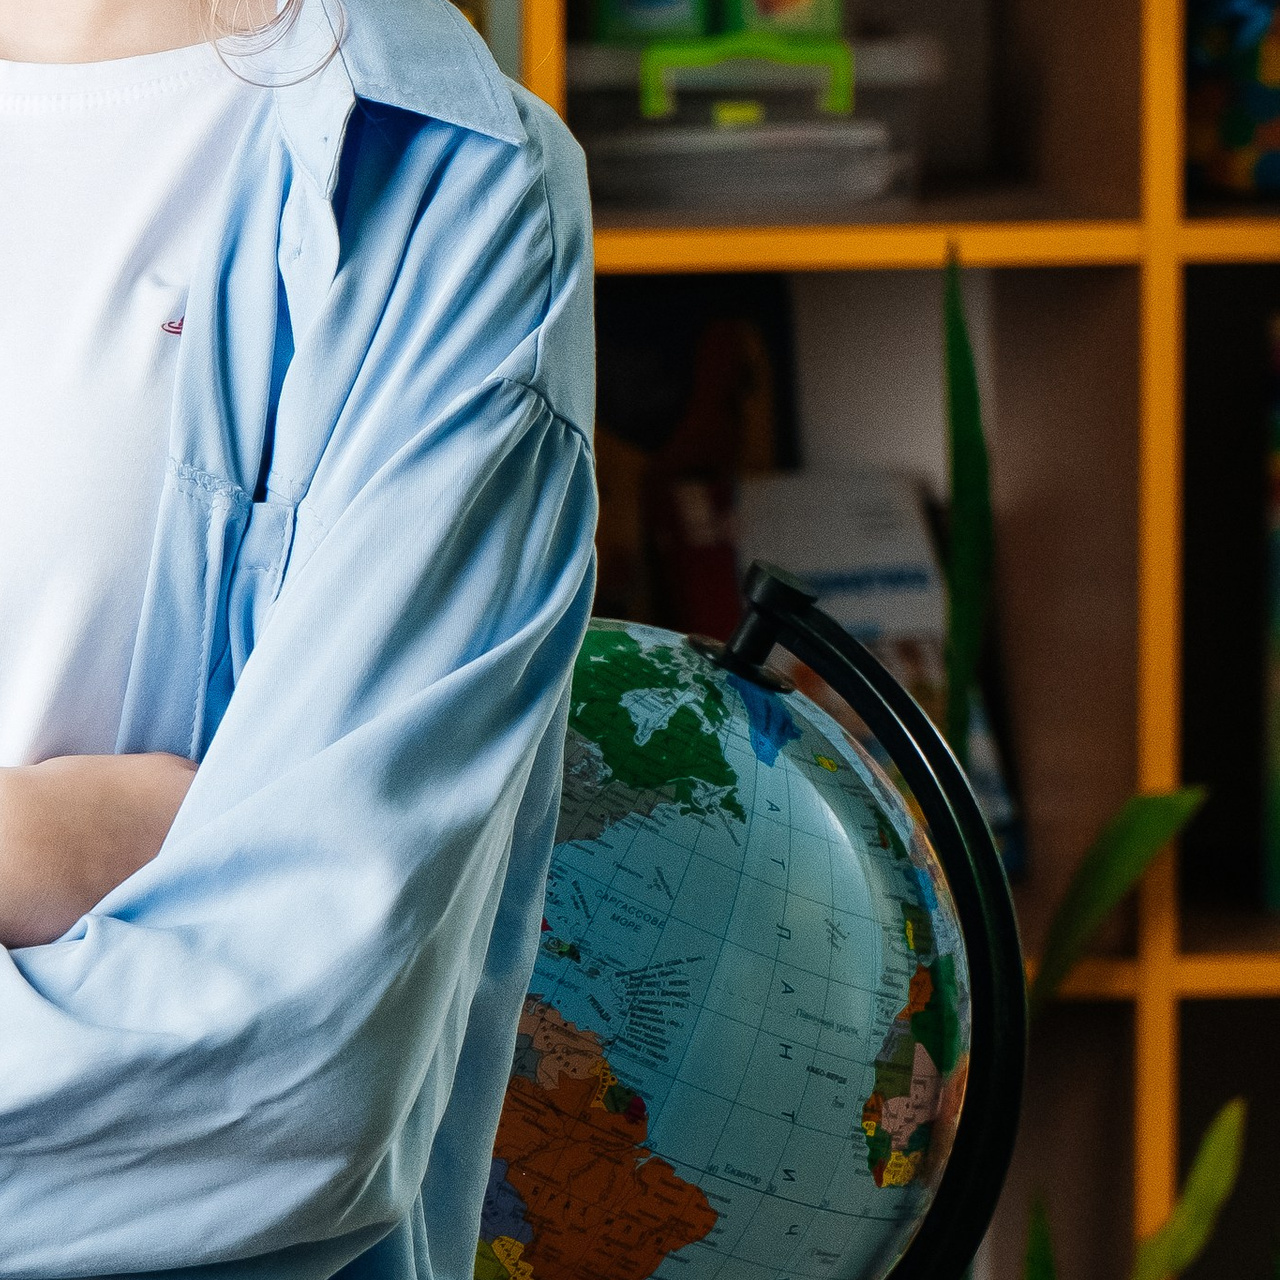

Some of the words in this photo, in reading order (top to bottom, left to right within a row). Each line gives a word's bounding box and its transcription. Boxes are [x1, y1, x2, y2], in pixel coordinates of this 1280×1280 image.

[595, 888, 667, 930] САРГАССОВЕ
[610, 913, 643, 934] МОРЕ
[724, 1163, 762, 1185] Екватор
